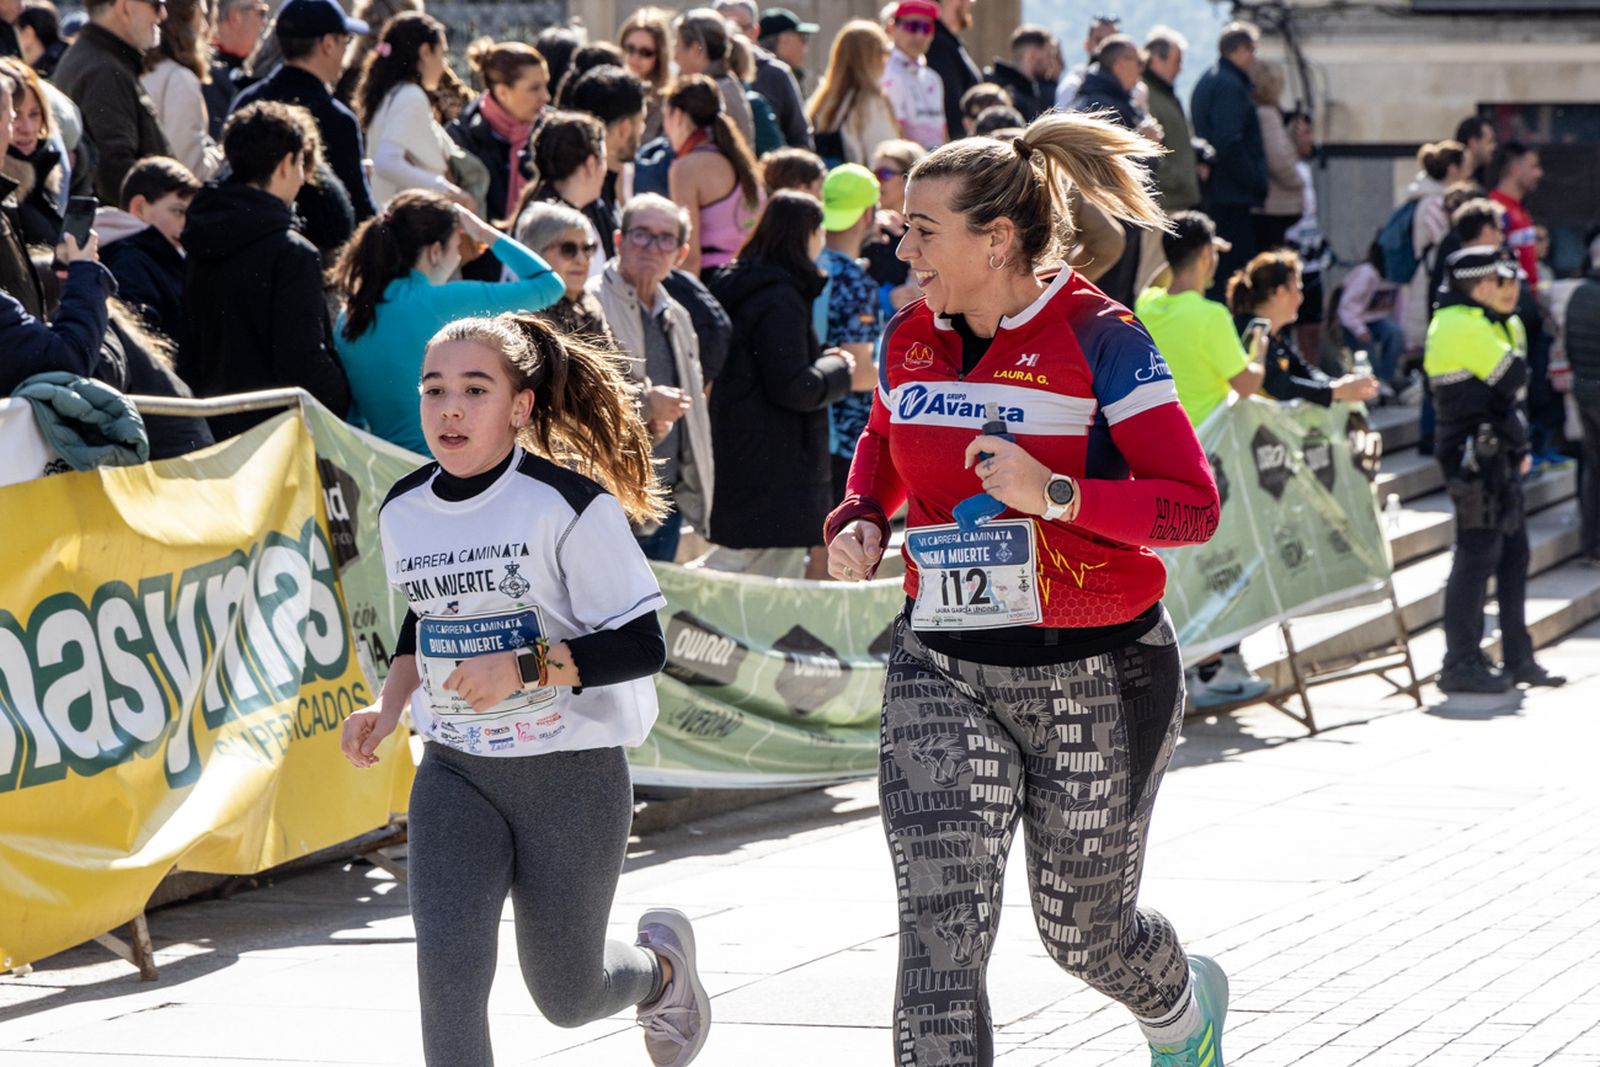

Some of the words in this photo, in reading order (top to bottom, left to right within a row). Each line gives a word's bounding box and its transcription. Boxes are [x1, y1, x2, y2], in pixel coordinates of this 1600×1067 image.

[993, 370, 1033, 382] LAURA
[1037, 375, 1049, 385] G.
[924, 393, 1024, 423] Avanza
[928, 533, 961, 546] CARRERA
[963, 530, 1013, 542] CAMINATA
[400, 551, 455, 573] CARRERA
[458, 542, 530, 563] CAMINATA
[948, 546, 990, 563] MUERTE
[434, 569, 497, 597] MUERTE
[941, 568, 991, 606] 112
[436, 623, 472, 635] CARRERA
[473, 618, 522, 633] CAMINATA
[429, 638, 459, 654] BUENA
[459, 635, 505, 653] MUERTE
